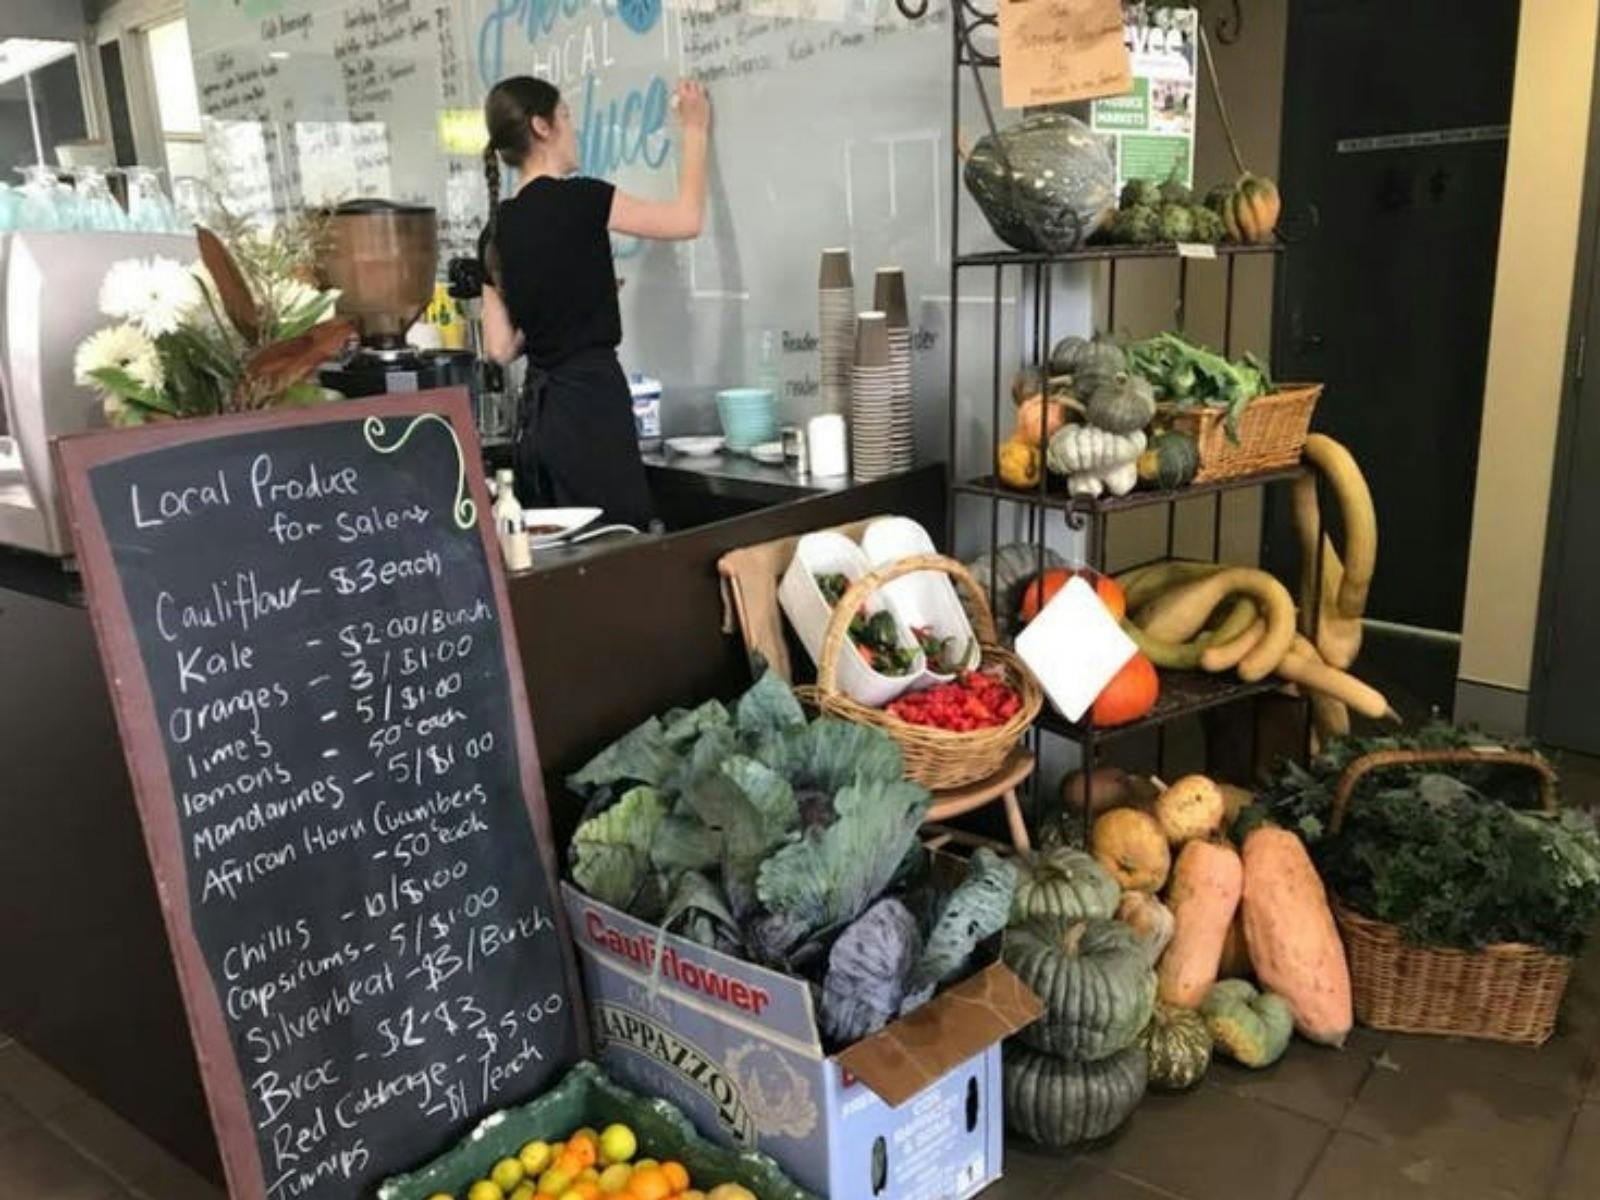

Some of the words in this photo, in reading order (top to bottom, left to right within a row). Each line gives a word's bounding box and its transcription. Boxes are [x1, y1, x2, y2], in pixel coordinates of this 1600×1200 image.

[131, 469, 230, 528] Local
[252, 453, 358, 507] Produce
[268, 511, 322, 544] for
[177, 640, 252, 693] Kale
[182, 762, 292, 818] lemons
[202, 843, 297, 903] African
[303, 817, 368, 855] Horn
[246, 960, 395, 1064] Silverbeat
[273, 1106, 326, 1170] Red
